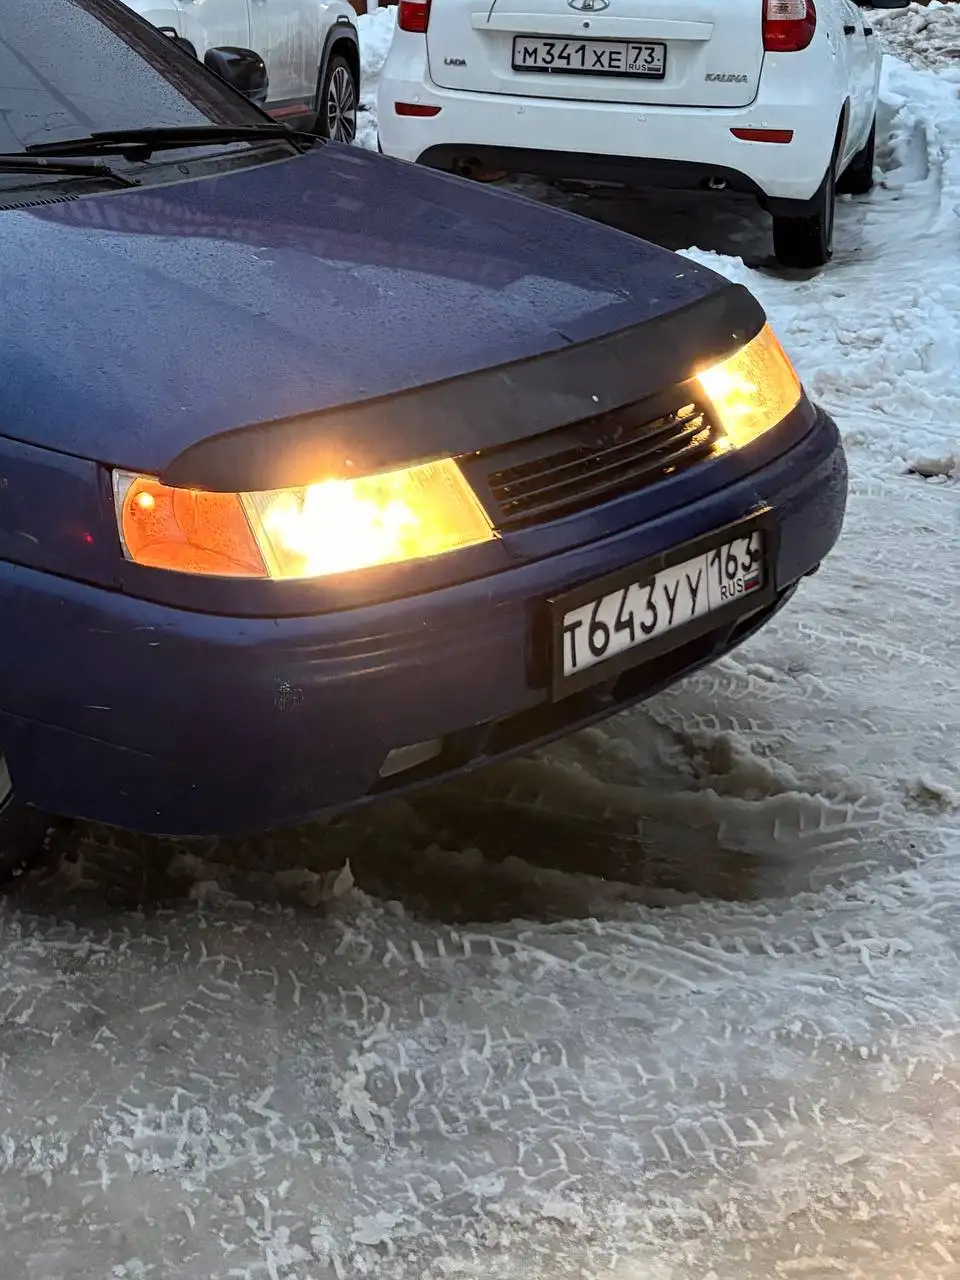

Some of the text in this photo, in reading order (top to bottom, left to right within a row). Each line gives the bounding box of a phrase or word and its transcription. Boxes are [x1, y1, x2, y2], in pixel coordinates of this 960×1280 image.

[631, 46, 655, 65] 73
[628, 63, 647, 71] RUS
[720, 578, 744, 600] RUS
